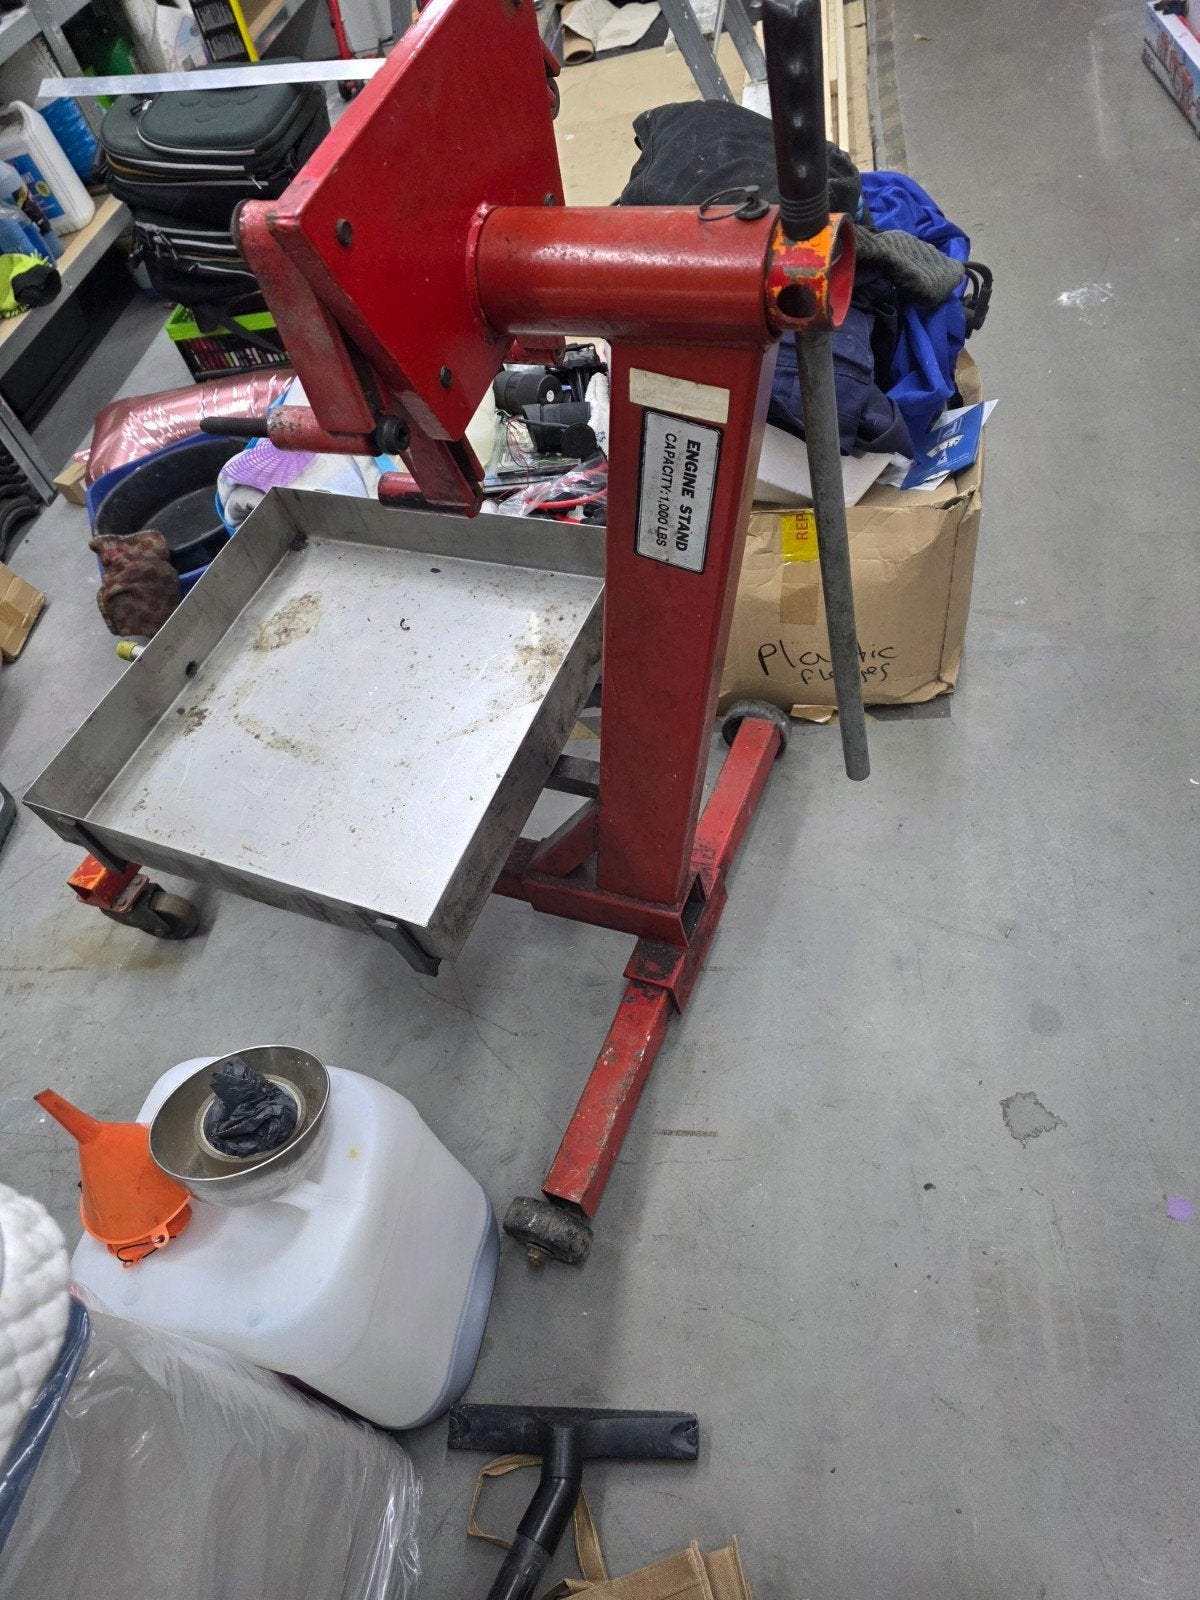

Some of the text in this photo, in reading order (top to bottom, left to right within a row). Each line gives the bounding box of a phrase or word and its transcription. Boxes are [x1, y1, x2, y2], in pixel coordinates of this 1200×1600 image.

[676, 438, 701, 552] ENGINE STAND
[656, 525, 668, 547] LBS
[757, 640, 897, 676] Platic
